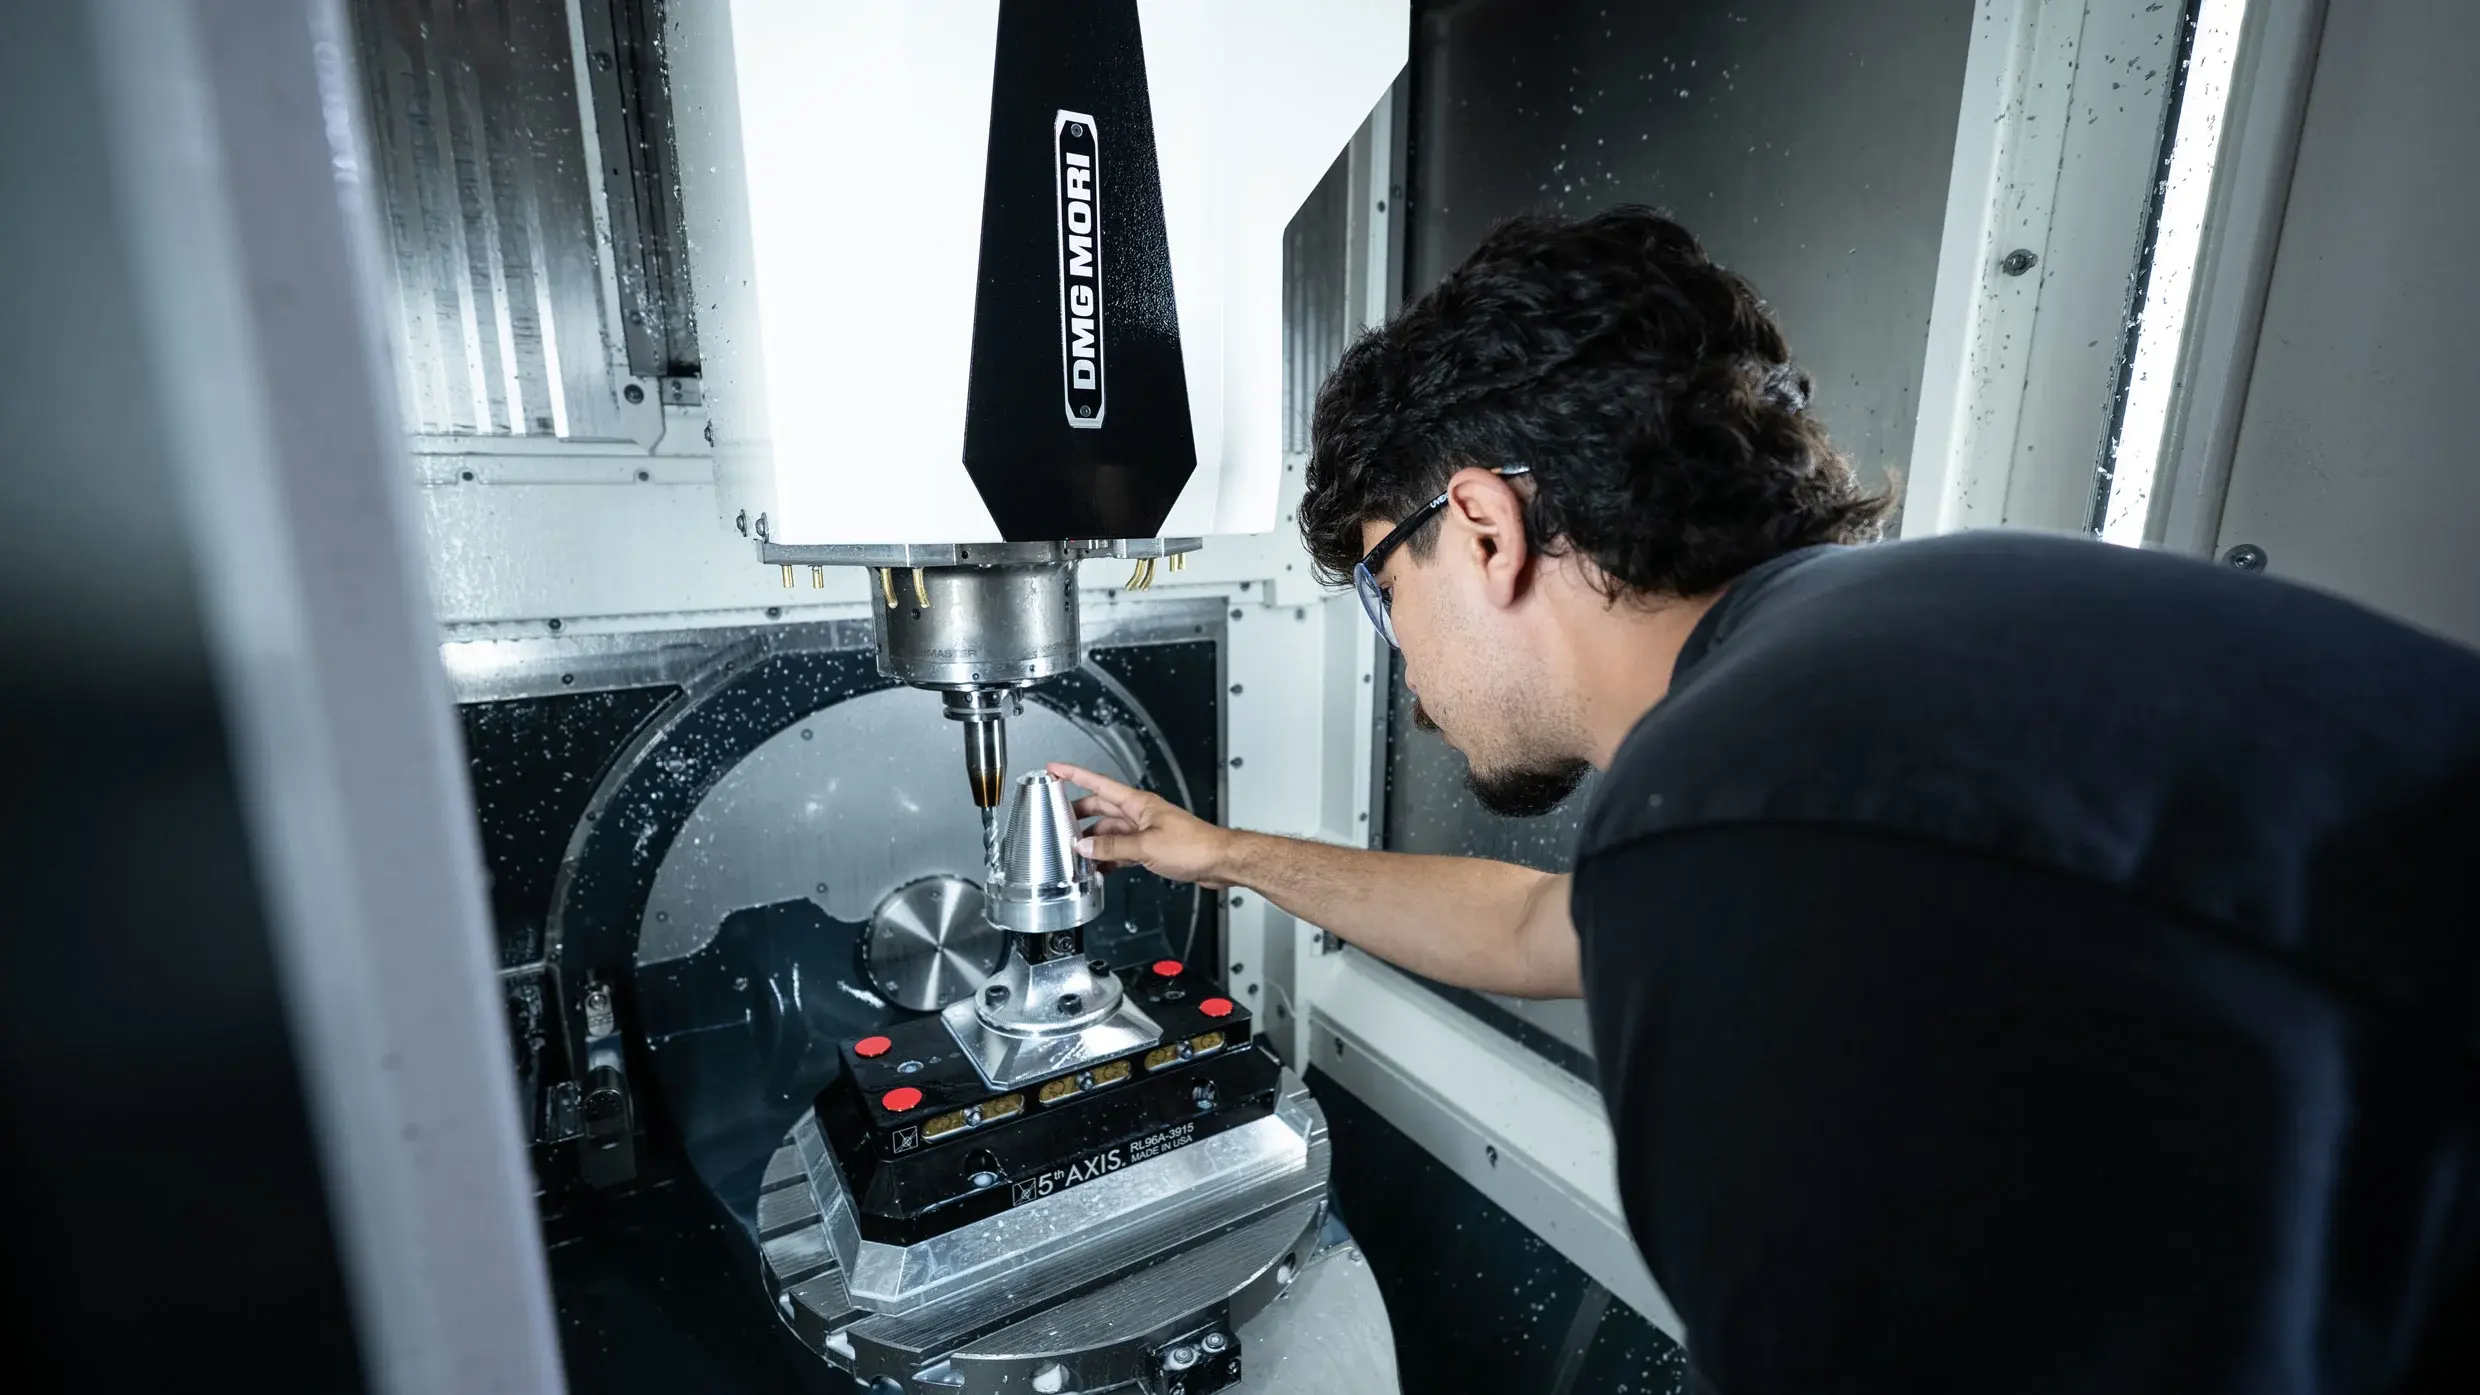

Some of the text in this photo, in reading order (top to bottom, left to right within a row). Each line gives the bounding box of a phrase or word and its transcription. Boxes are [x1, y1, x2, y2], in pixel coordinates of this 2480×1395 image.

[1066, 152, 1096, 390] DMG MORI
[1130, 1122, 1194, 1153] RL96A-3915
[1131, 1134, 1193, 1163] MADE IN USA
